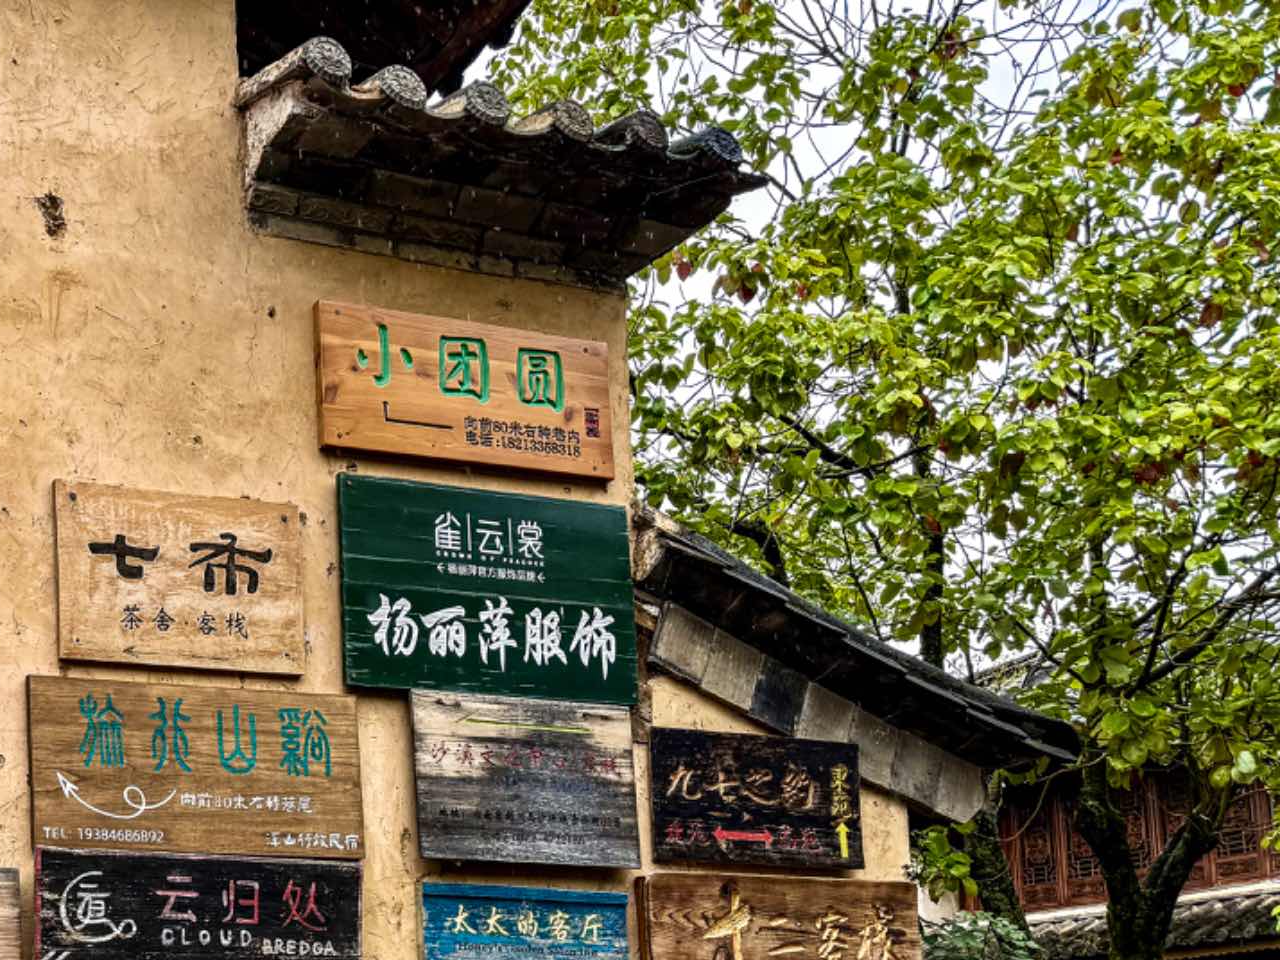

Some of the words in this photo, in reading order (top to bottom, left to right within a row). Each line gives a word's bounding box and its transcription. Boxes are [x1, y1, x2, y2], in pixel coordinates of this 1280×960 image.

[356, 322, 565, 413] 小团圆
[366, 592, 617, 681] 杨丽萍服饰
[154, 874, 328, 932] 云归处
[446, 903, 604, 945] 太太的客厅
[160, 928, 253, 947] CLOUD
